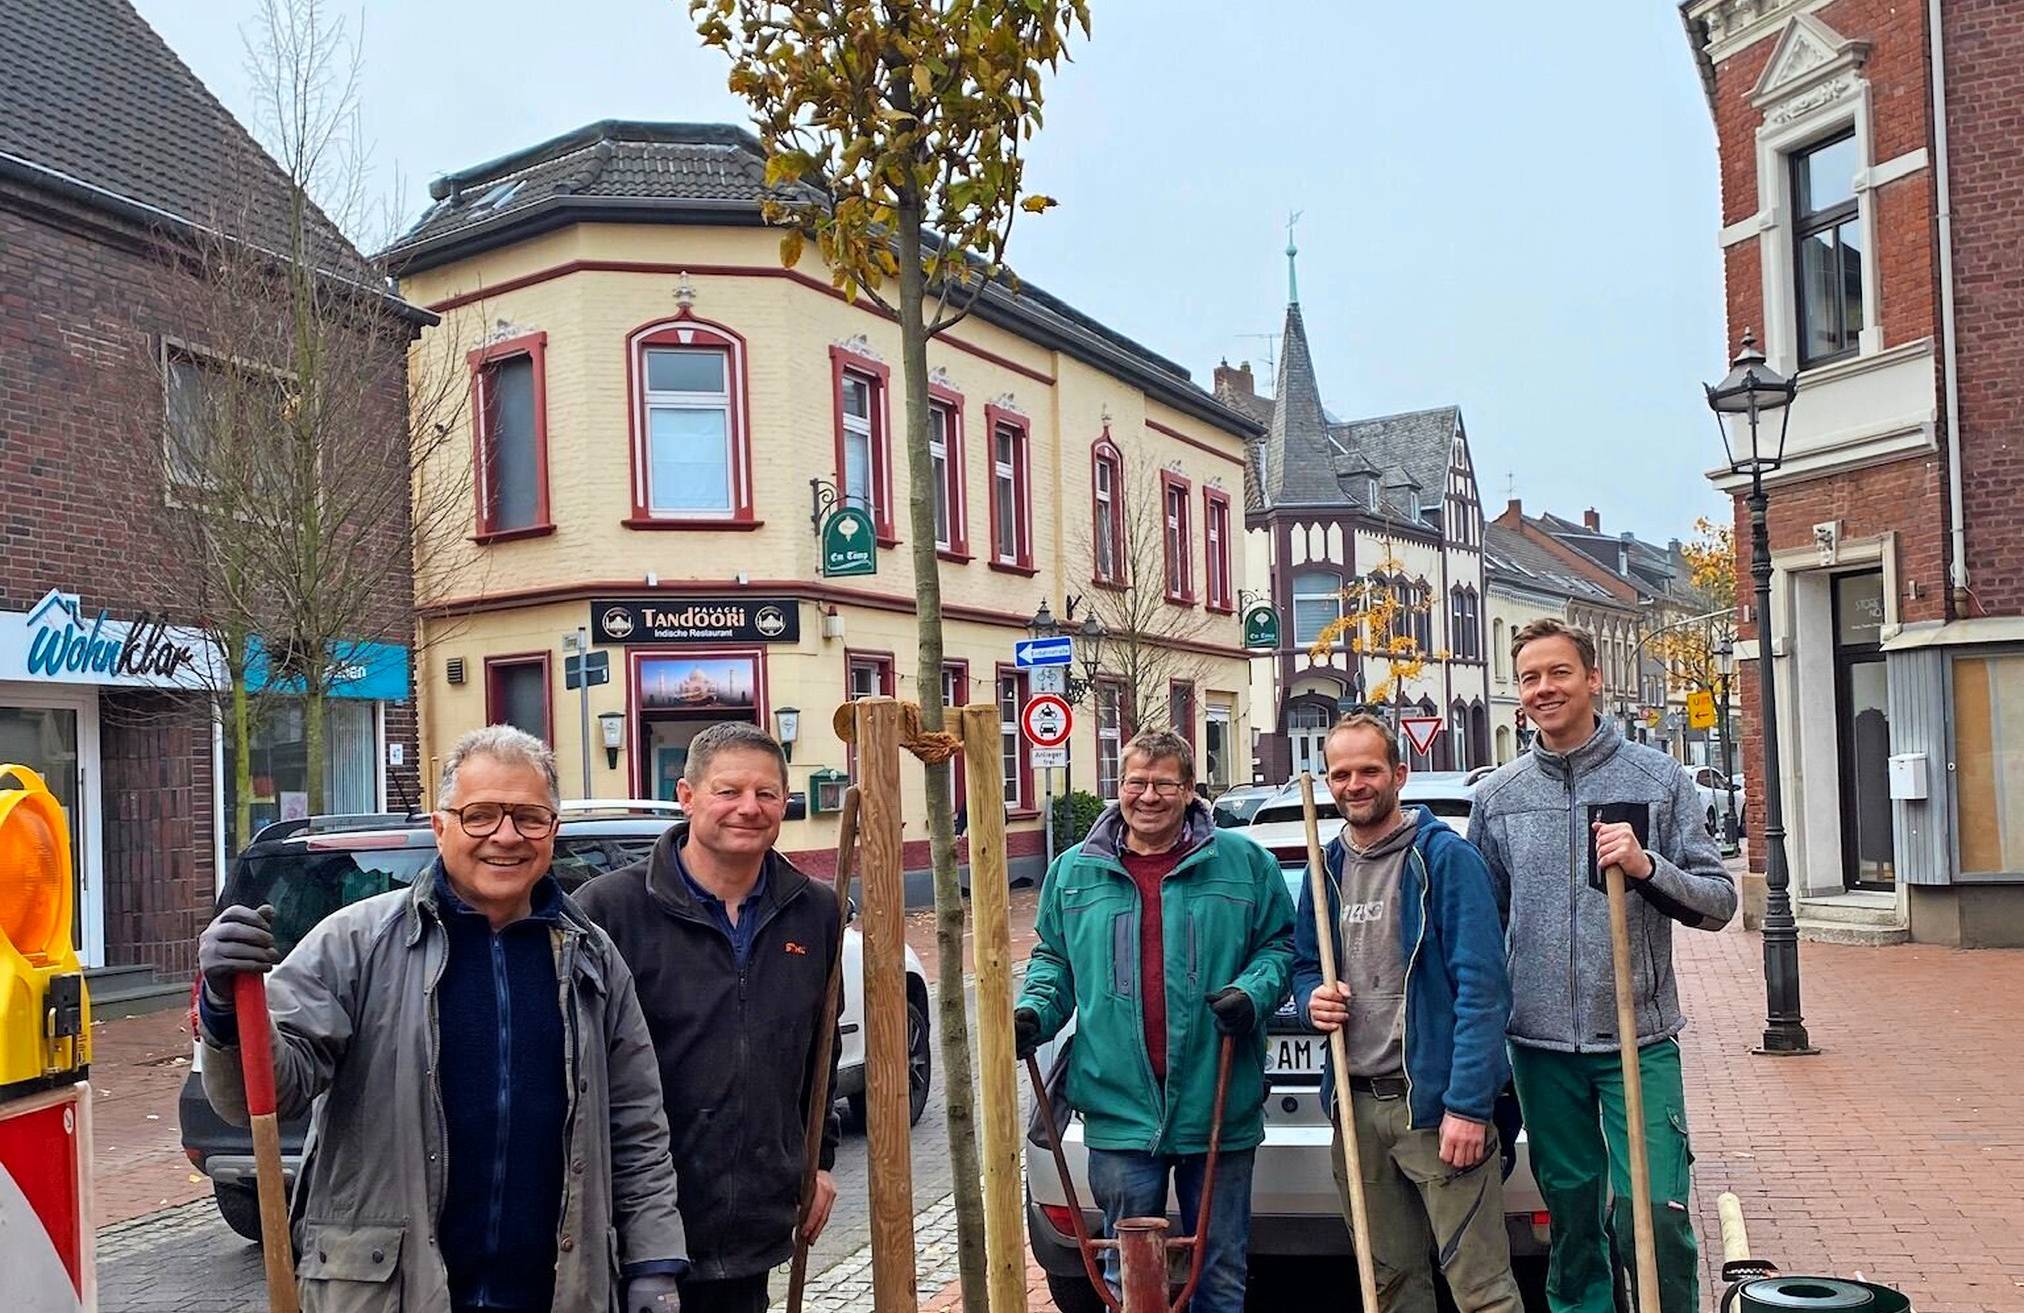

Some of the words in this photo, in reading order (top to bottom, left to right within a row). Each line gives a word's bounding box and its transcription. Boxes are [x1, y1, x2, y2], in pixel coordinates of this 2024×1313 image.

[694, 606, 737, 614] PALACE
[654, 628, 688, 638] Indische
[689, 628, 733, 638] Restaurant
[27, 610, 194, 678] Wohnklar
[1277, 1039, 1311, 1070] AM
